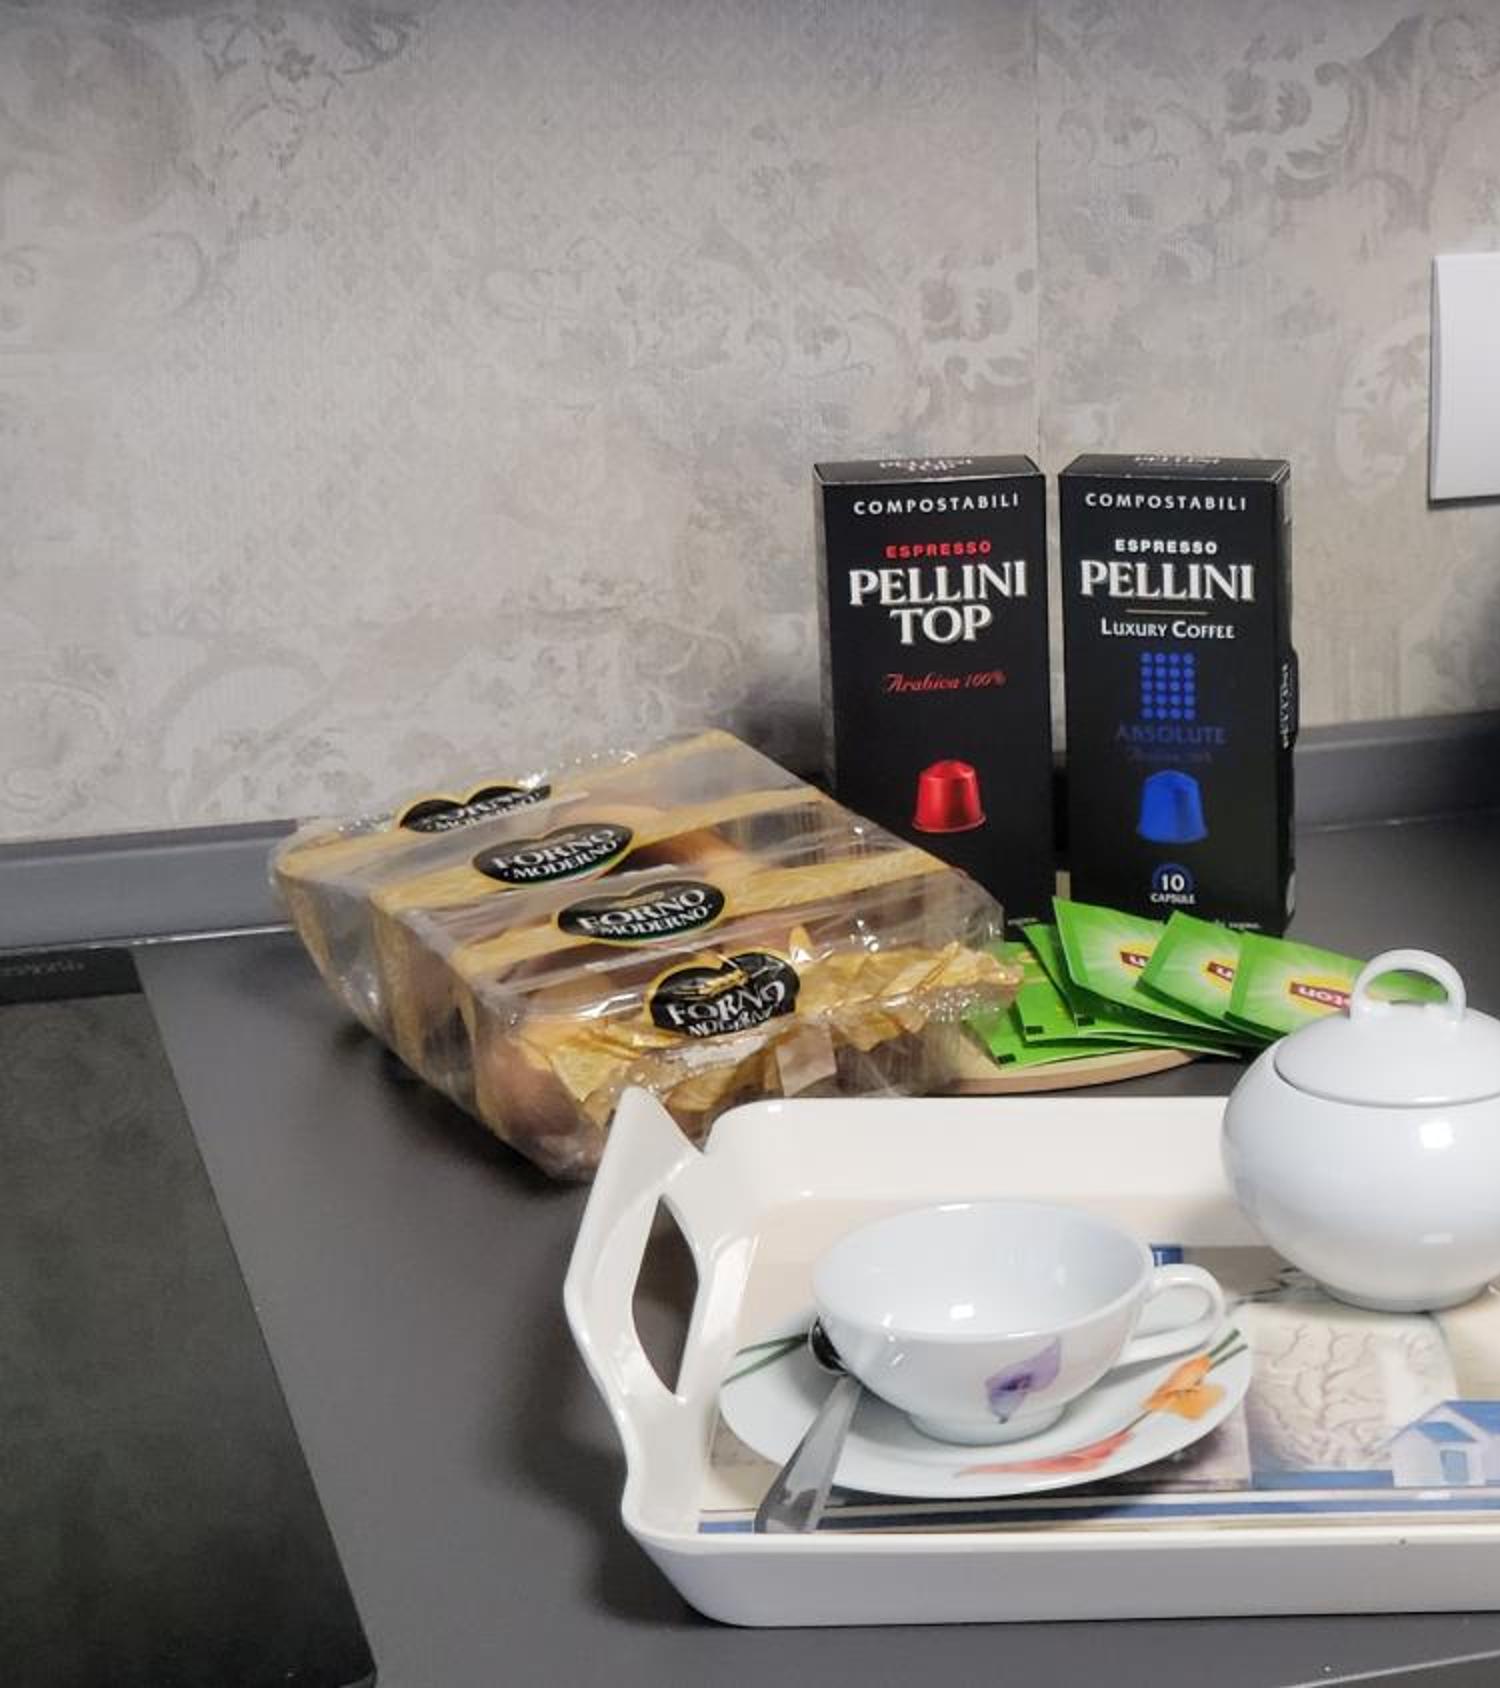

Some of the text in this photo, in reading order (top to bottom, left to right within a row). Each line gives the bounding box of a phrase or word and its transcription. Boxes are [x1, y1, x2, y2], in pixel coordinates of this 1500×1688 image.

[853, 493, 1020, 515] COMPOSTABILI
[1085, 493, 1248, 512] COMPOSTABILI
[885, 540, 992, 559] ESPRESSO
[1115, 539, 1218, 555] ESPRESSO
[848, 560, 1027, 606] PELLINI
[1080, 559, 1255, 602] PELLINI
[889, 604, 993, 645] TOP
[884, 672, 960, 692] Arabica
[1114, 724, 1227, 744] ABSOLUTE
[492, 829, 615, 870] FORNO
[512, 840, 618, 879] MODERNO
[1161, 873, 1185, 892] 10
[577, 889, 705, 930] FORNO
[1150, 893, 1196, 905] CAPSULE
[600, 904, 710, 937] MODERNO
[667, 980, 786, 1026] FORNO
